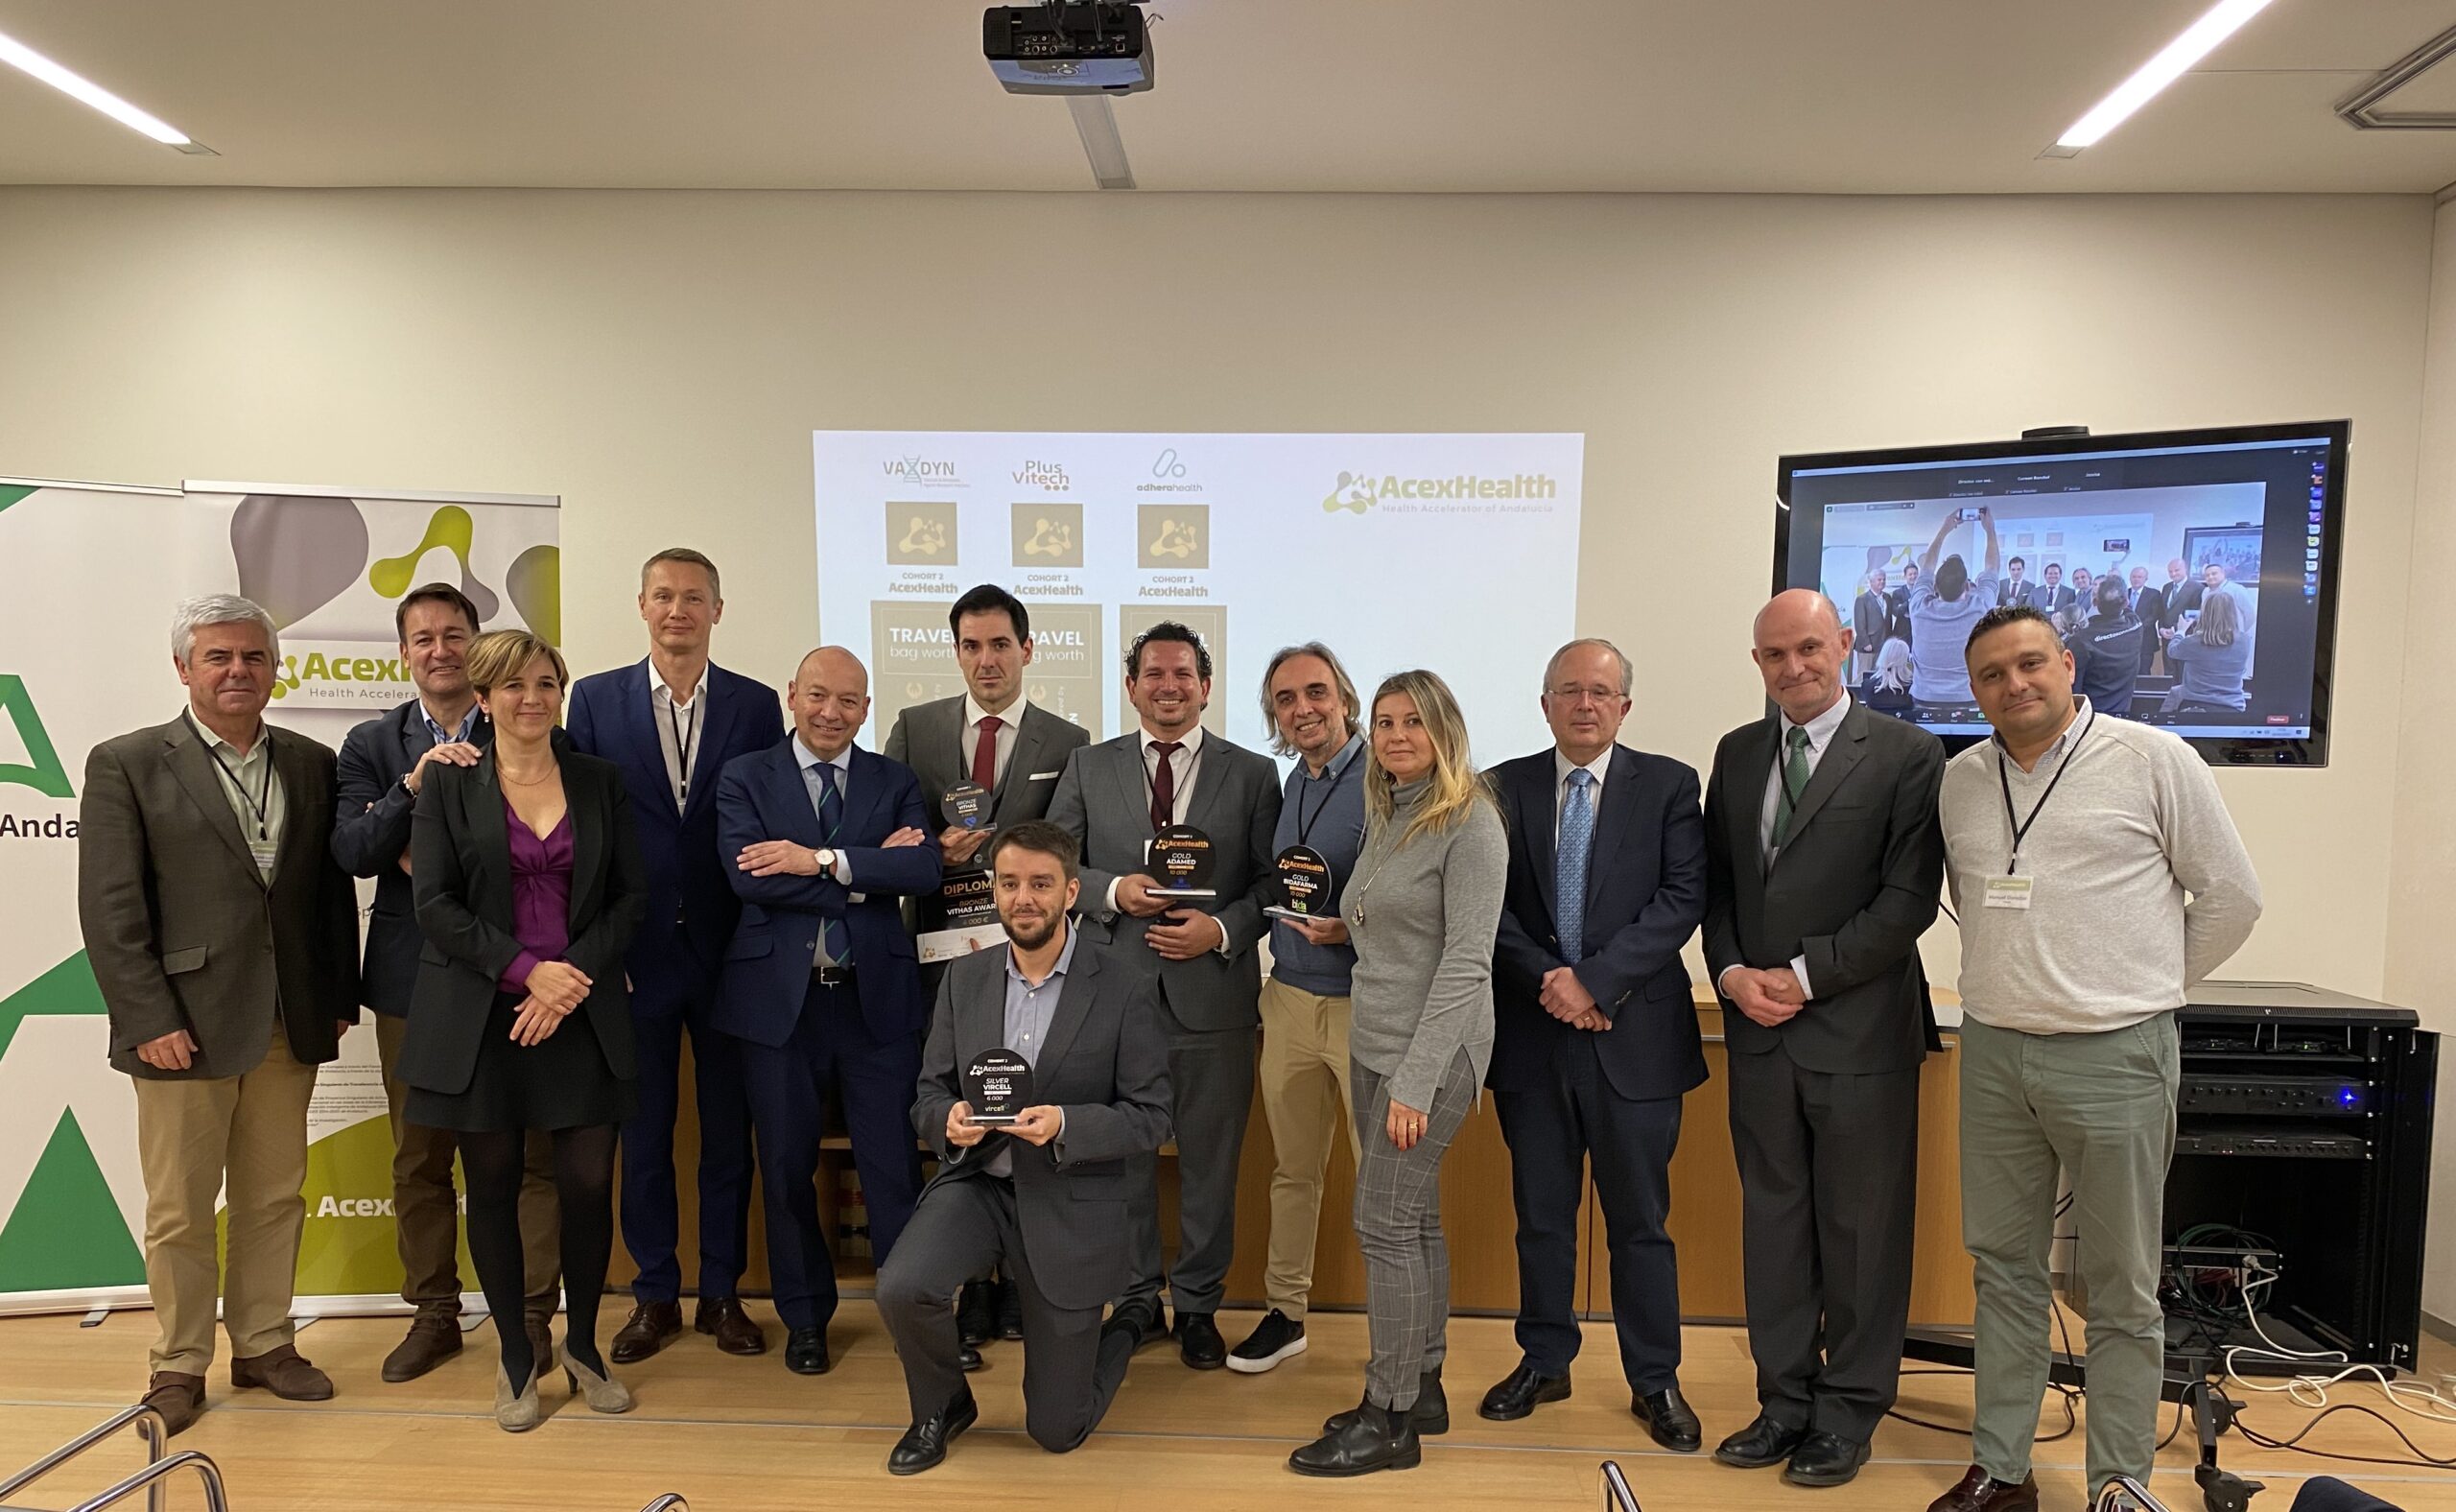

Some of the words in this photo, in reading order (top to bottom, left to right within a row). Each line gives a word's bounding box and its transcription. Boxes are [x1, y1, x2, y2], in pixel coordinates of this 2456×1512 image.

[1025, 461, 1062, 474] Plus
[1012, 471, 1070, 484] Vitech
[1136, 483, 1203, 492] adherahealth
[1379, 474, 1556, 499] AcexHealth
[1382, 505, 1418, 513] Health
[1421, 504, 1481, 513] Accelerator
[1485, 504, 1497, 513] of
[902, 572, 937, 580] COHORT
[1027, 574, 1062, 582] COHORT
[888, 582, 958, 594] AcexHealth
[1013, 584, 1084, 596] AcexHealth
[1138, 586, 1209, 597] AcexHealth
[1028, 630, 1084, 646] RAVEL
[890, 645, 918, 660] bag
[1045, 649, 1084, 661] worth
[310, 688, 354, 697] Health
[359, 689, 421, 699] Accelera
[1283, 878, 1318, 889] BIDAFARMA
[958, 897, 988, 907] BRONZE
[946, 906, 973, 915] VITHAS
[317, 1195, 396, 1218] Acex
